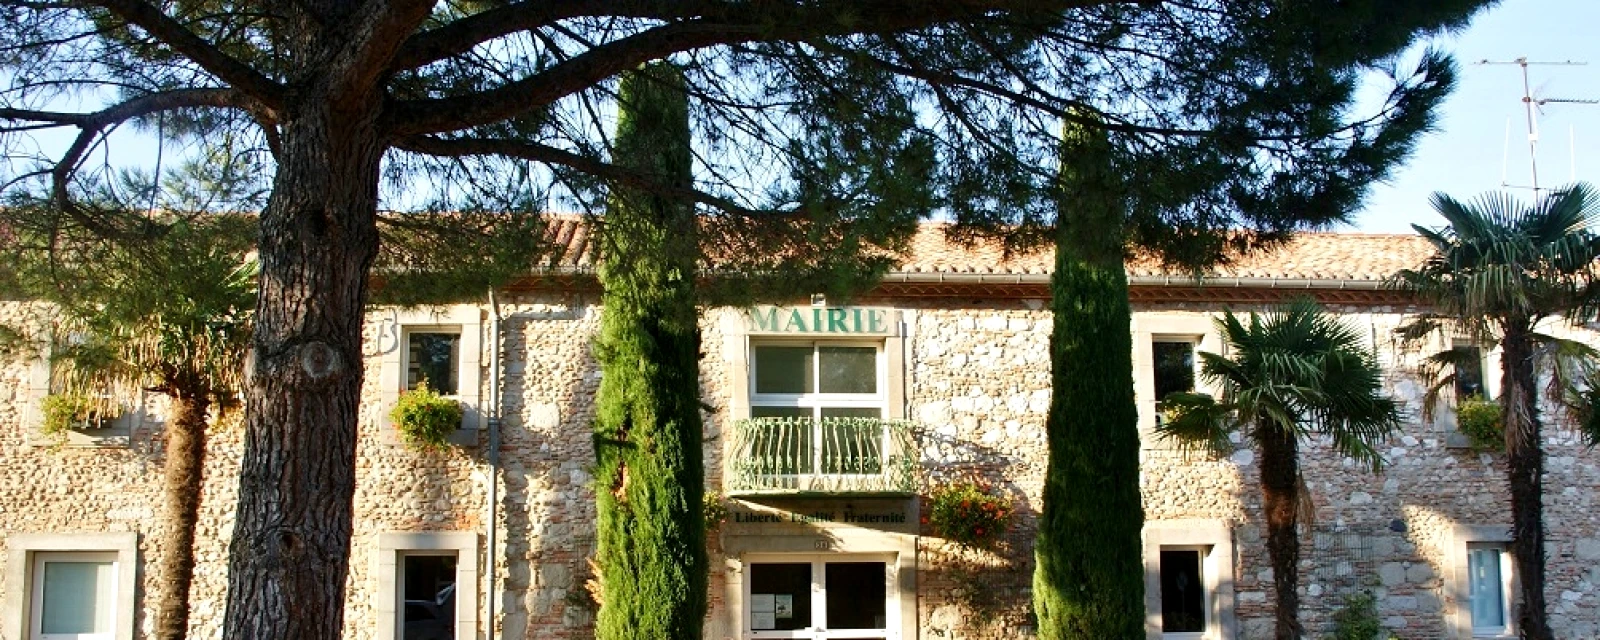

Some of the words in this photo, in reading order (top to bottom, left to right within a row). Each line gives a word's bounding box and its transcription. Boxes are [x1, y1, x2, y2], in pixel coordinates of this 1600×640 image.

[749, 307, 888, 333] MAIRIE
[735, 511, 782, 523] Liberté
[844, 511, 906, 523] Fraternité
